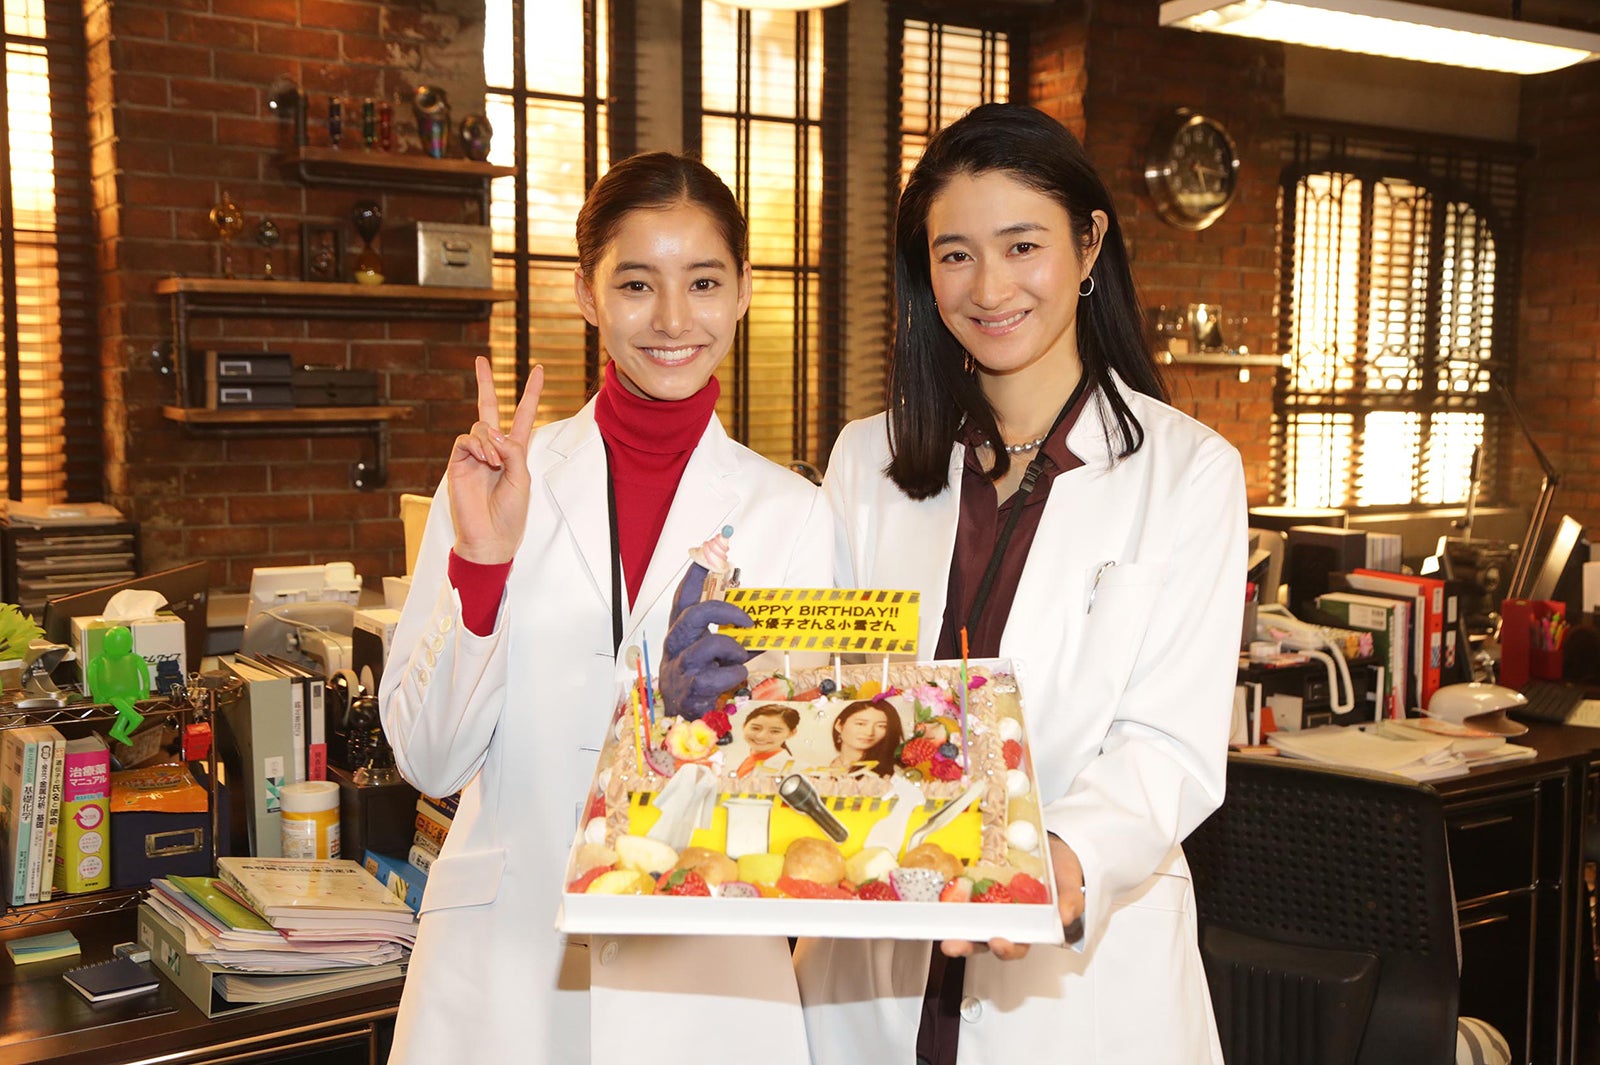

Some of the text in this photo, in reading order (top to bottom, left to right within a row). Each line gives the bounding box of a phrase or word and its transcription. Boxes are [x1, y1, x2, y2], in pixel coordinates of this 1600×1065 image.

[741, 604, 899, 618] APPY BIRTHDAY!!
[734, 617, 897, 632] 木優子さん&小雪さん
[69, 763, 107, 778] 治療薬
[69, 774, 107, 787] マニュアル
